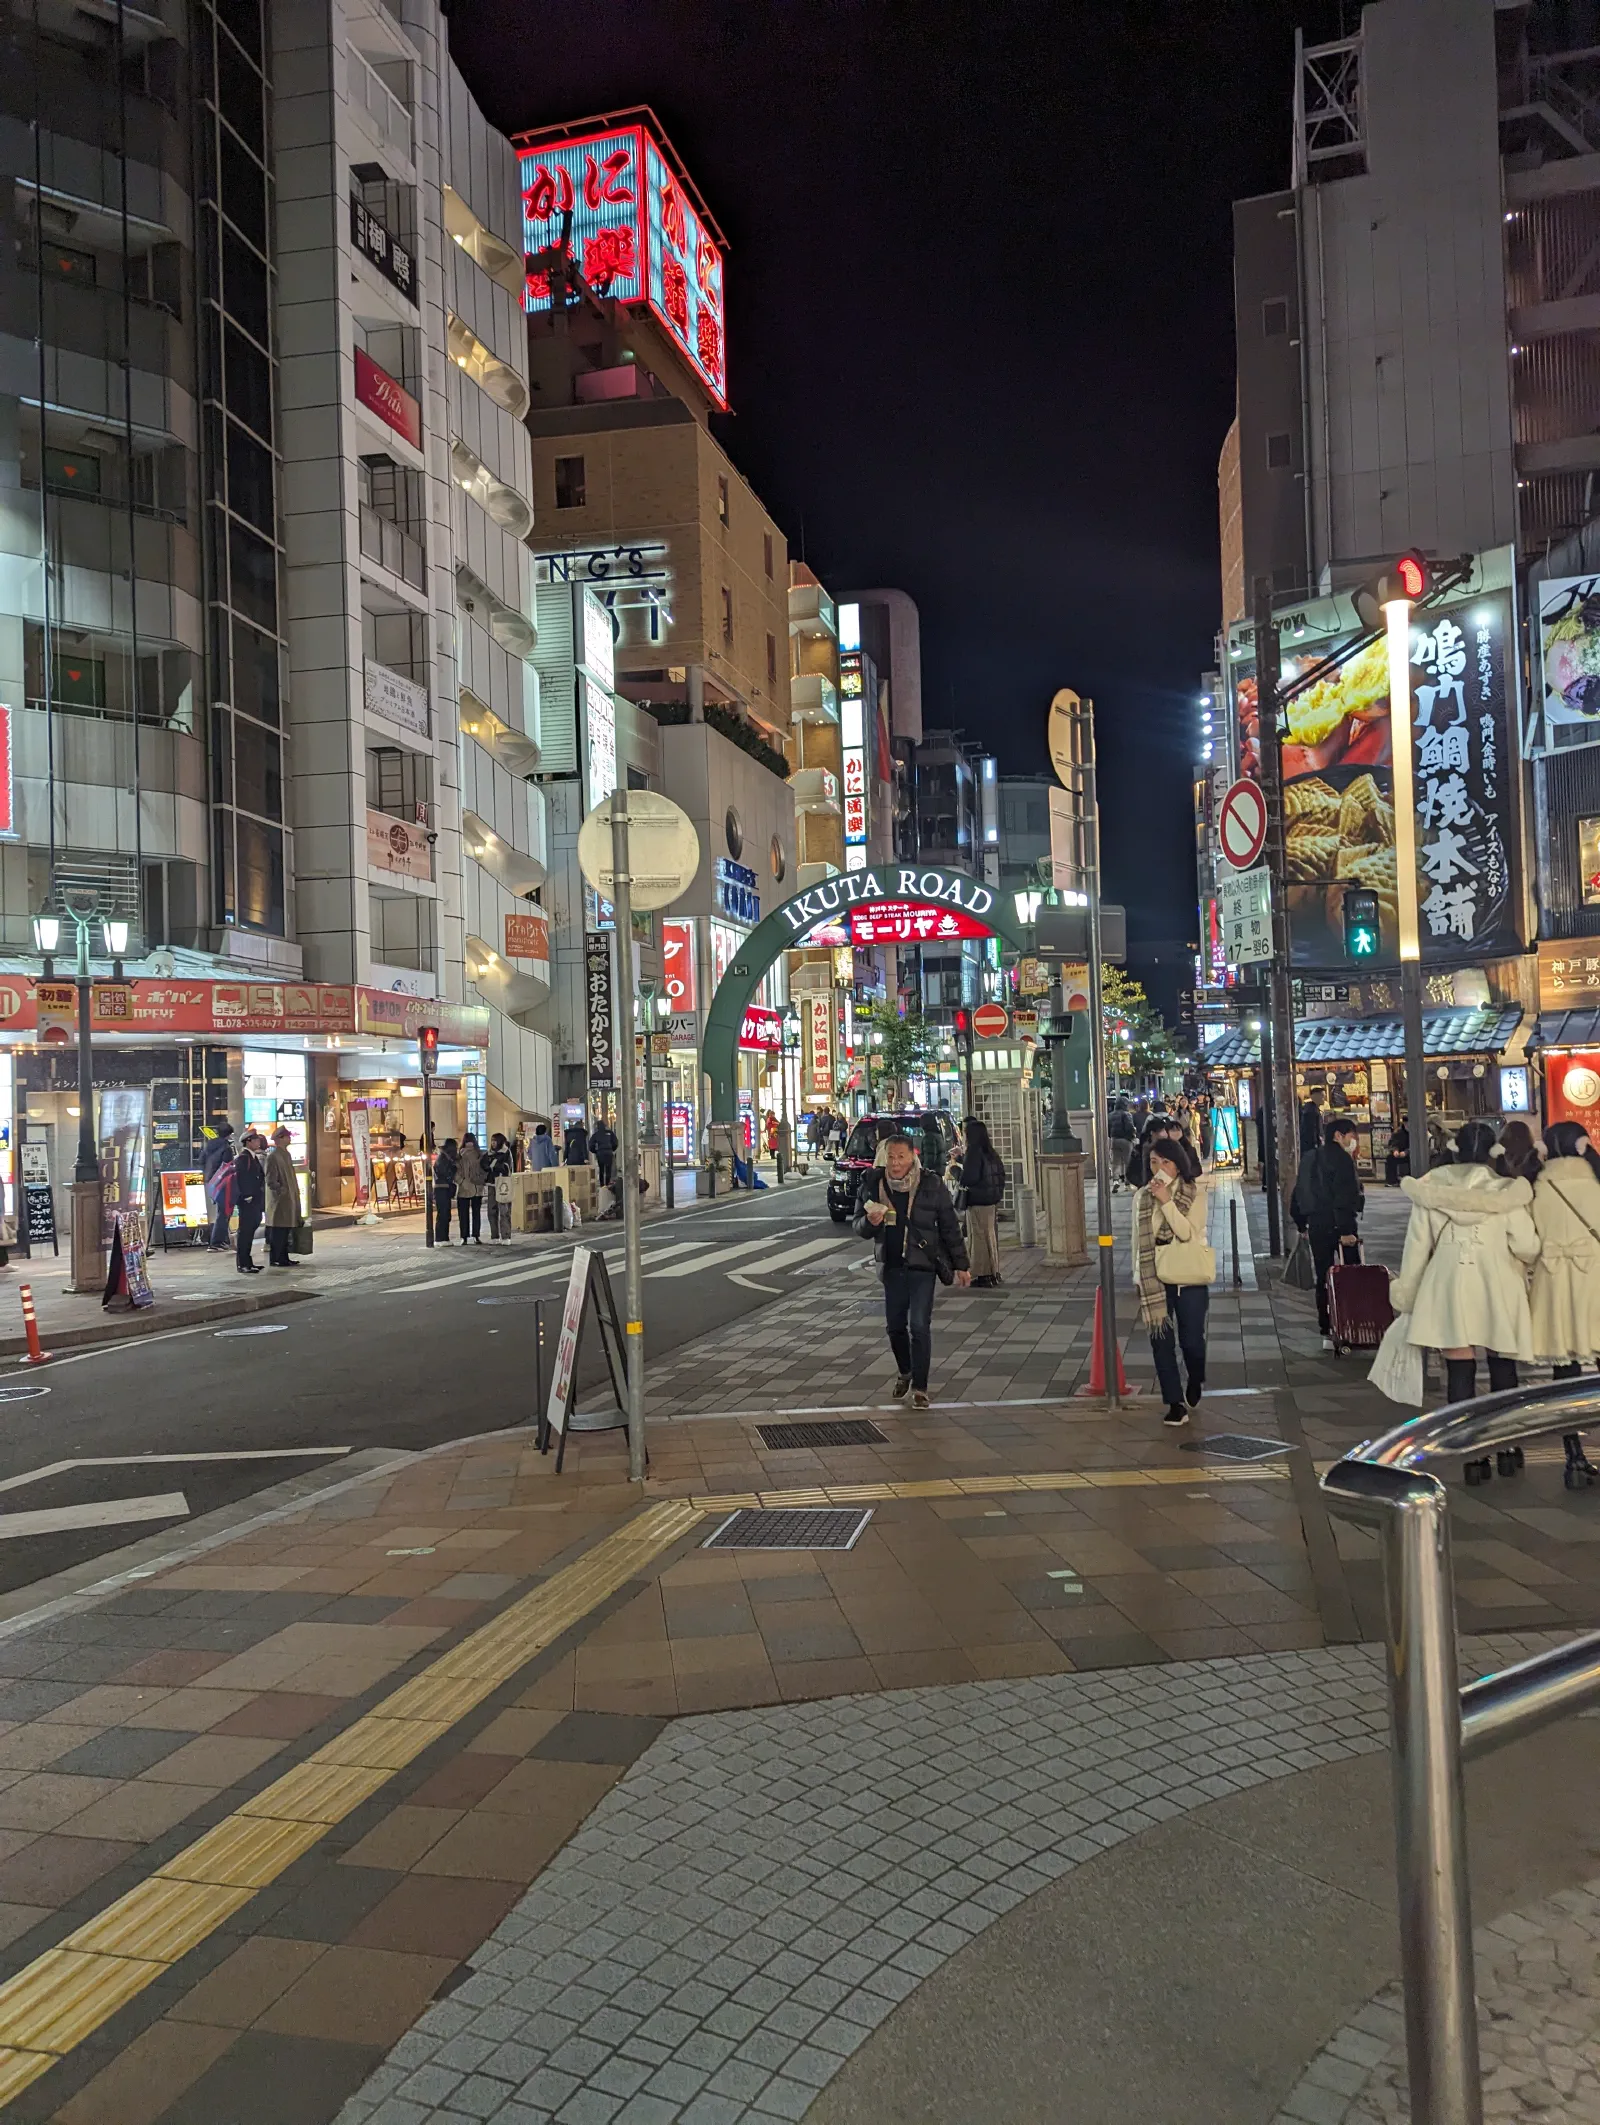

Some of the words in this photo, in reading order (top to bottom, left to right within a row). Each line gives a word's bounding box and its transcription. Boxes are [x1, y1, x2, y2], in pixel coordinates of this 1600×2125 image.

[523, 150, 634, 221] かに
[1477, 623, 1493, 700] 勝産あずき
[1479, 713, 1497, 799] 鳴門金時いも
[1410, 619, 1480, 941] 鳴門鯛焼本舗
[1484, 812, 1502, 897] アイスもなか
[782, 873, 884, 930] IKUTA
[897, 870, 993, 914] ROAD
[903, 909, 937, 918] MOURIYA
[855, 917, 934, 940] モーリヤ
[1234, 920, 1260, 940] 貨物
[1551, 957, 1600, 975] 神戸豚
[147, 990, 204, 1004] ポパイ
[589, 972, 610, 1074] おたからや
[55, 1080, 126, 1088] イシノルディング
[1508, 1070, 1519, 1111] たいやき
[169, 1197, 183, 1205] BAR
